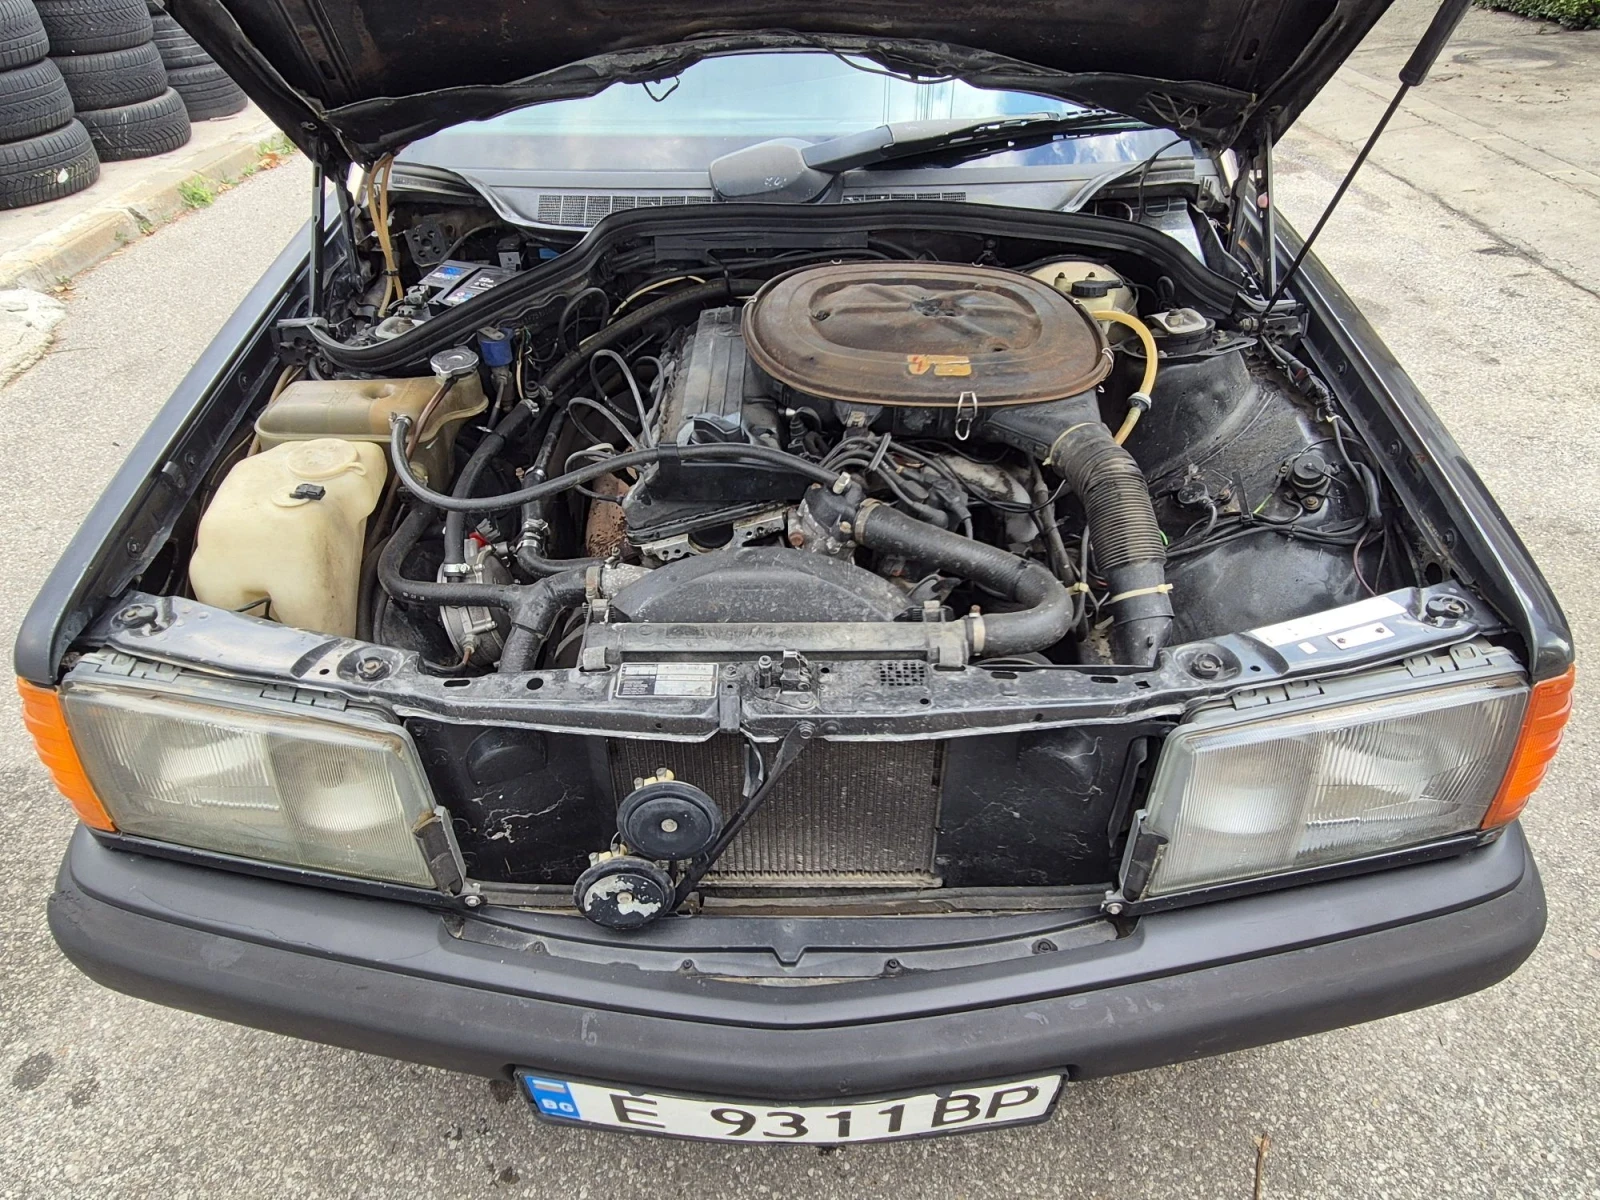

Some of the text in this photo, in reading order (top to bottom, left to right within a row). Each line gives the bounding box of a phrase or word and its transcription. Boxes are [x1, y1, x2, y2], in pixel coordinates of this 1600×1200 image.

[541, 1099, 575, 1113] BG
[609, 1085, 1039, 1138] E 9311 BP
